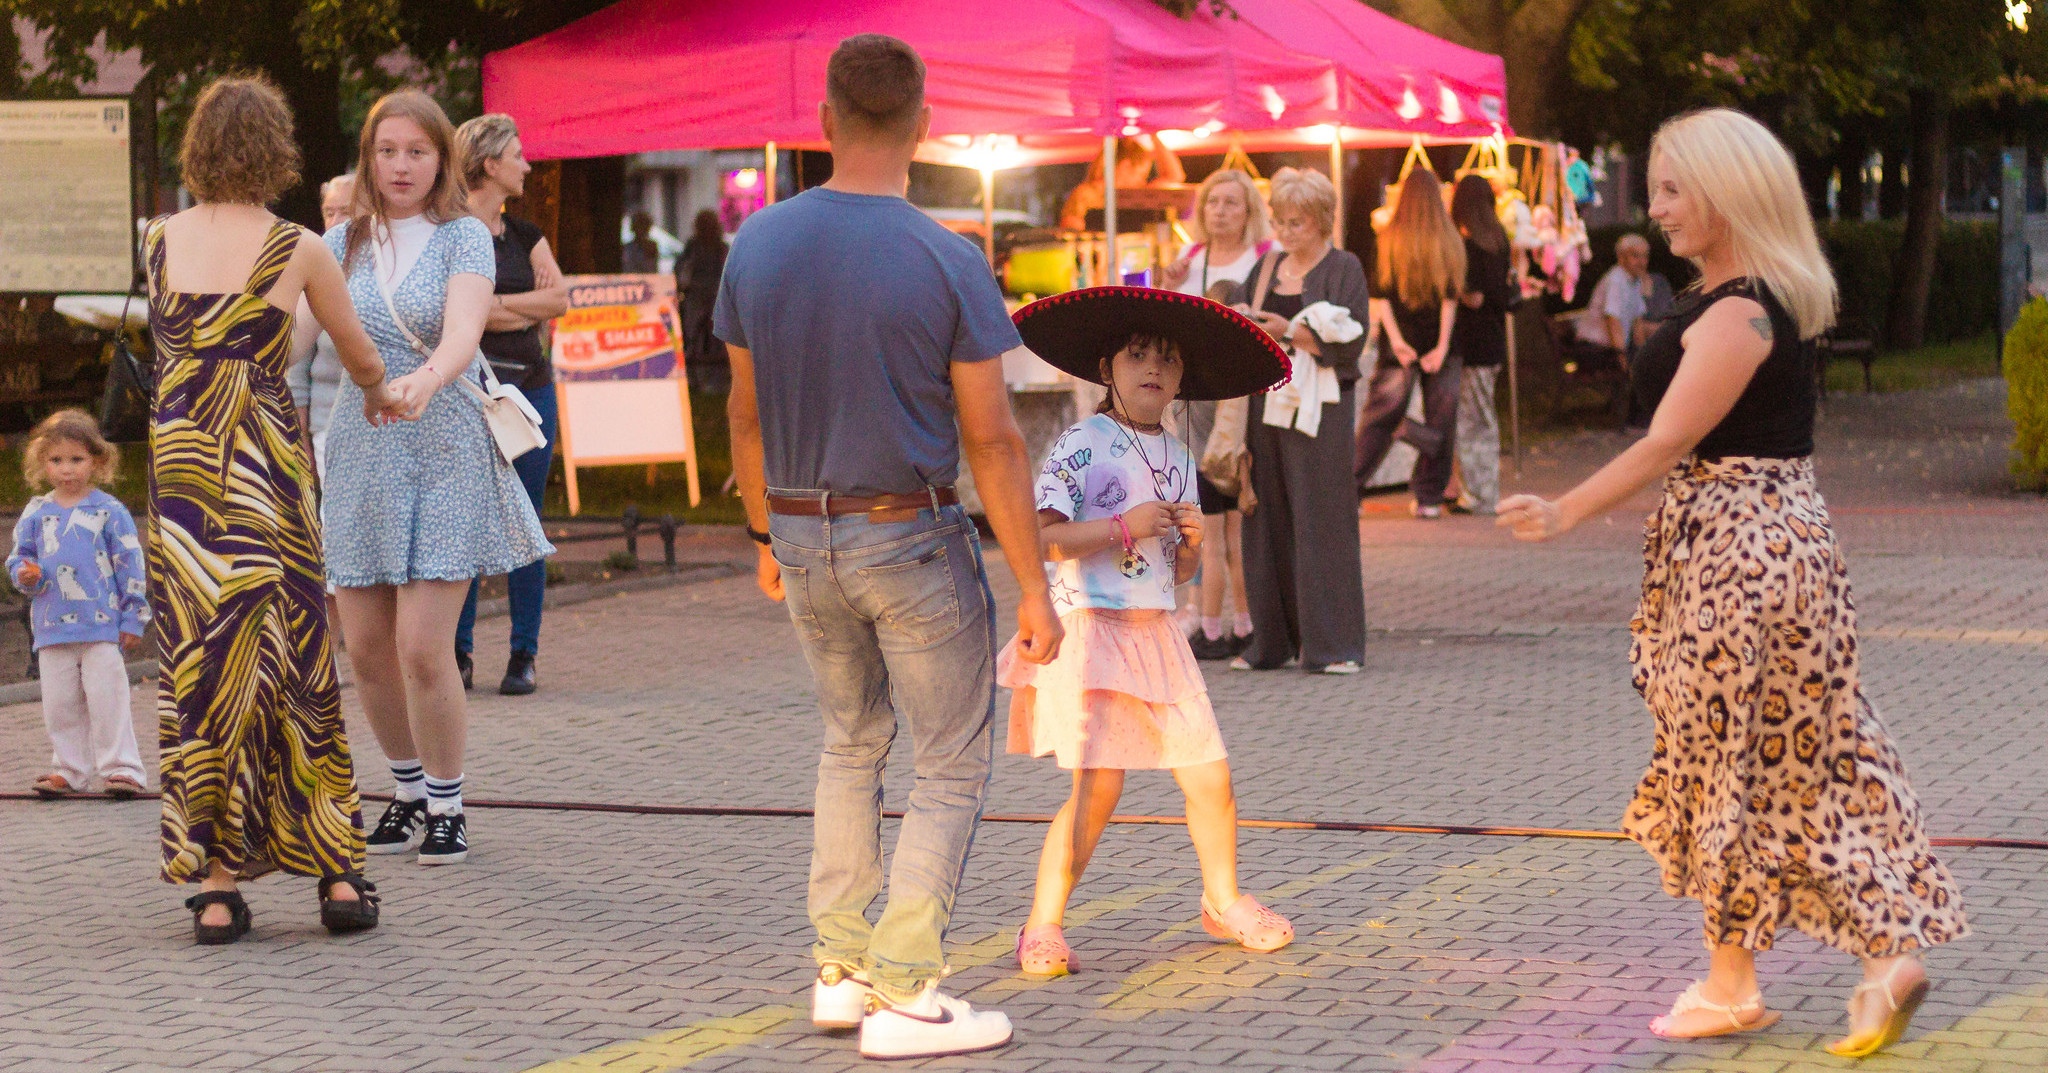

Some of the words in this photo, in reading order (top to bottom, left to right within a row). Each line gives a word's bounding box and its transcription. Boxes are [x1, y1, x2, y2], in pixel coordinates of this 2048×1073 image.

[571, 285, 645, 306] SORBETY
[562, 342, 595, 361] ICE
[604, 327, 655, 347] SHAKE
